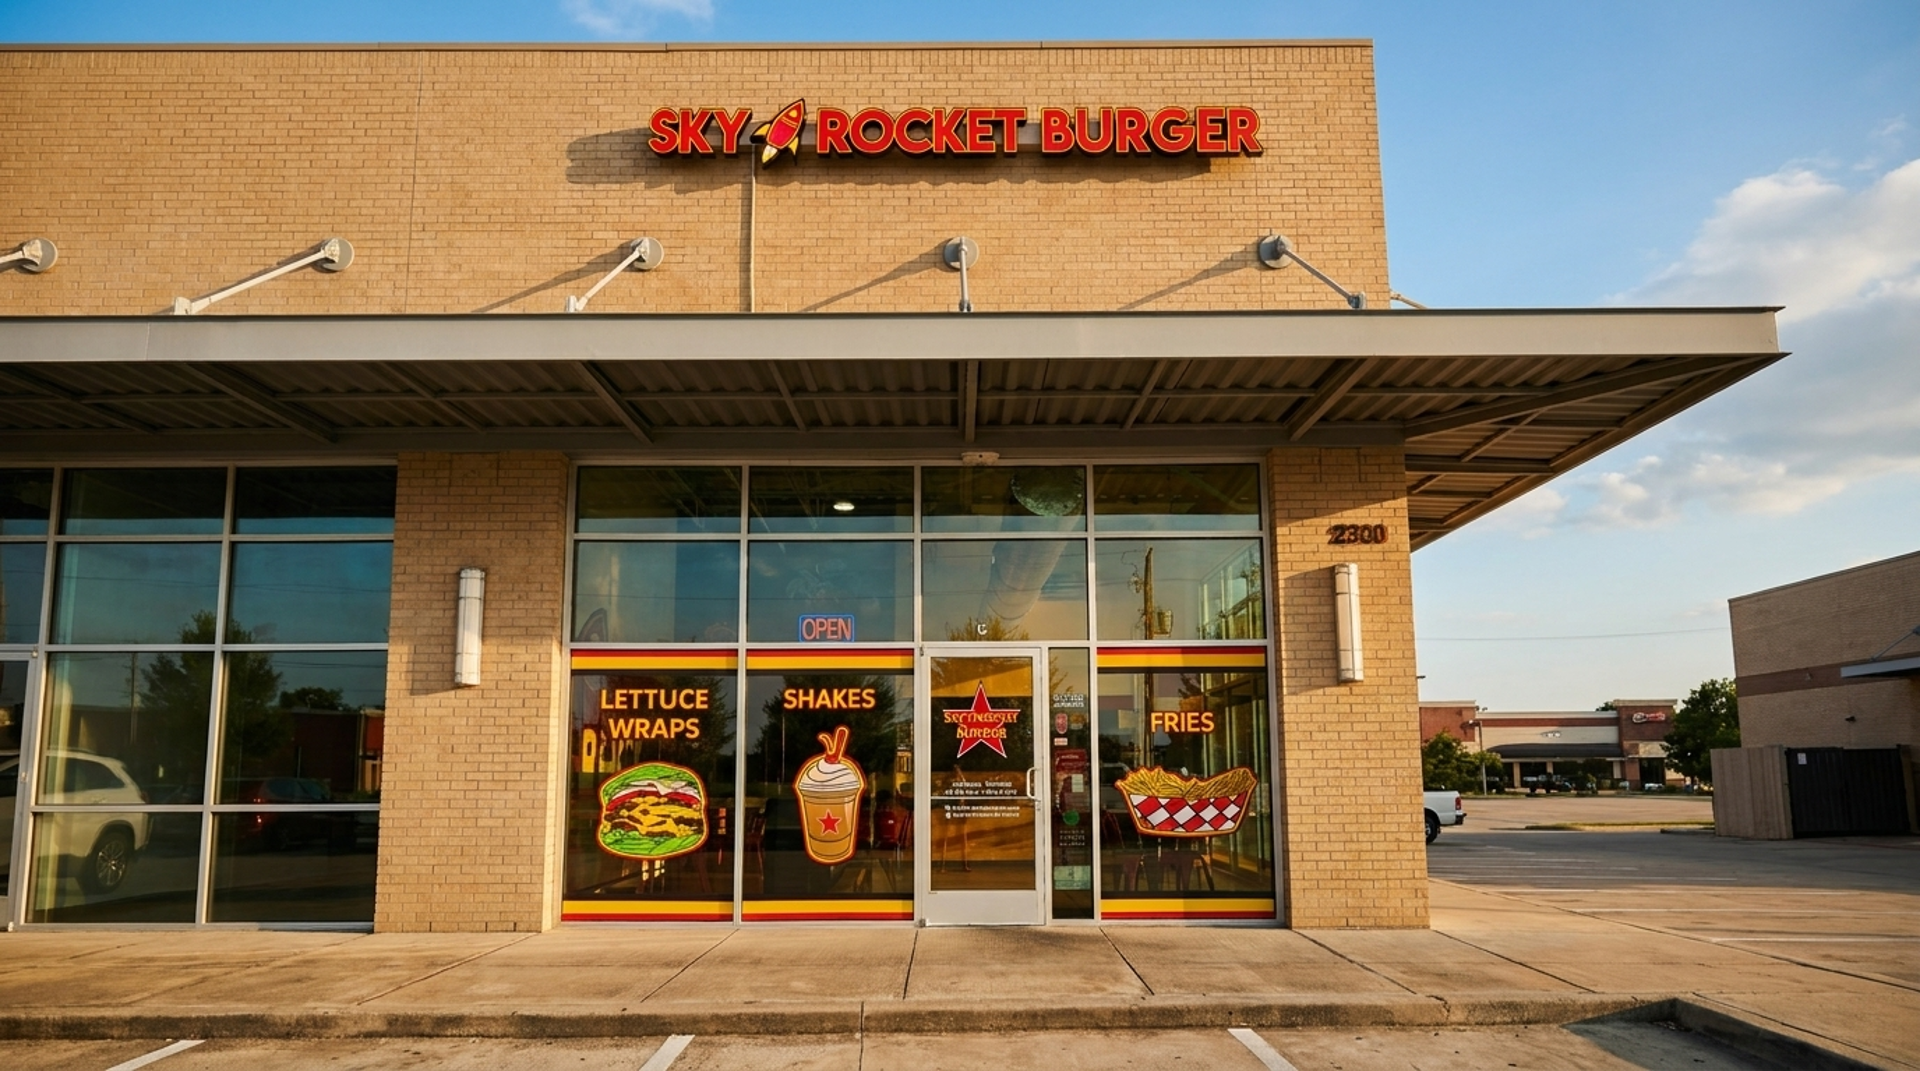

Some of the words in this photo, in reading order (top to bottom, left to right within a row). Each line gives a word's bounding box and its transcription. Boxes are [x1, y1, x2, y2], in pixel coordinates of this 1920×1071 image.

[648, 107, 751, 156] SKY
[816, 107, 1028, 156] ROCKET
[1040, 106, 1263, 156] BURGER
[1326, 524, 1388, 545] 2300
[802, 618, 851, 640] OPEN
[600, 689, 709, 710] LETTUCE
[783, 688, 875, 710] SHAKES
[608, 718, 700, 739] WRAPS
[1151, 712, 1215, 733] FRIES
